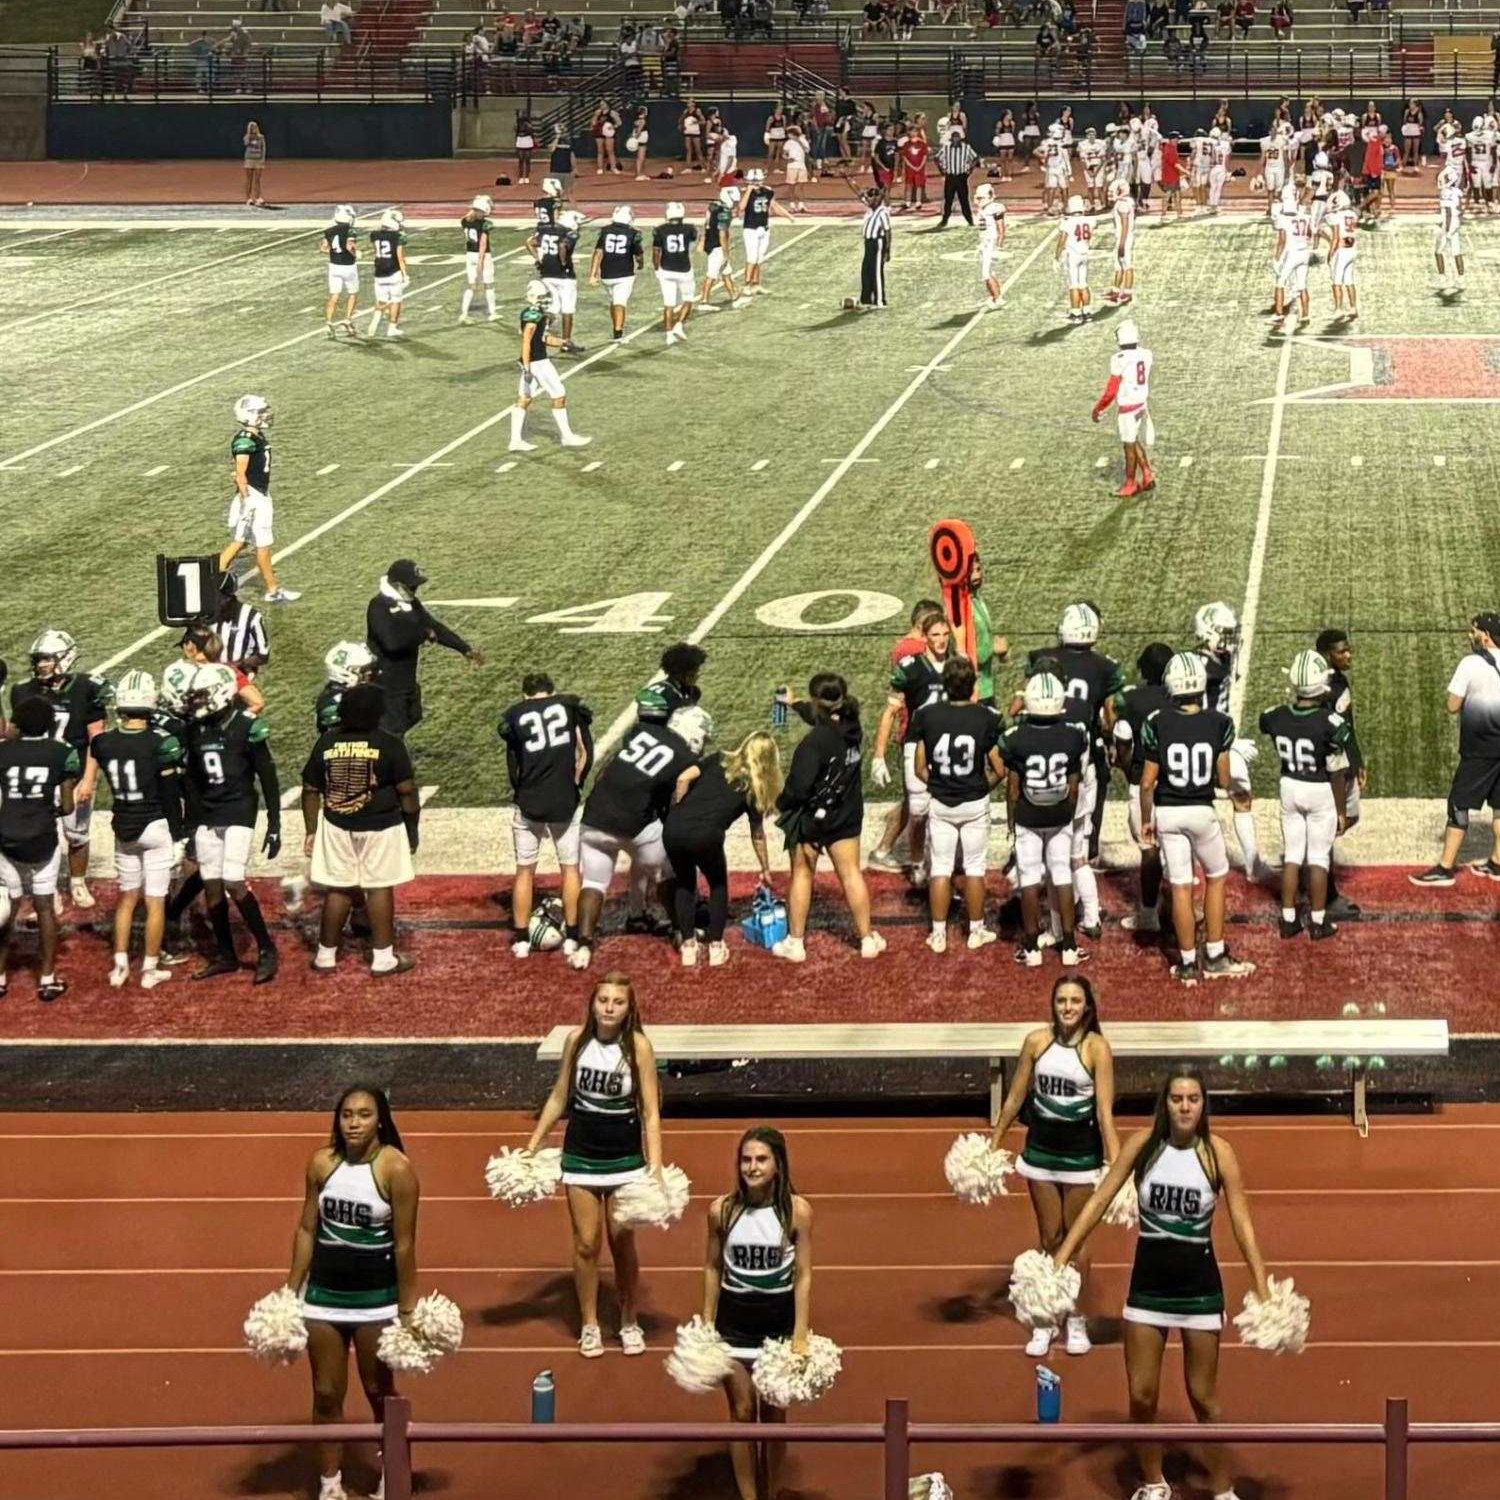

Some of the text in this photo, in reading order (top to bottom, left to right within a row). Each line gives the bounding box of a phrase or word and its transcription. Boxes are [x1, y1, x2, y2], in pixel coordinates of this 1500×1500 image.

[332, 234, 342, 253] 4
[604, 233, 627, 254] 62
[666, 234, 685, 253] 61
[1074, 223, 1092, 242] 48
[374, 239, 392, 258] 12
[1136, 361, 1146, 385] 8
[177, 562, 201, 614] 1
[518, 703, 571, 753] 32
[203, 751, 225, 785] 9
[618, 730, 675, 778] 50
[932, 733, 976, 777] 43
[1167, 742, 1213, 788] 90
[6, 765, 49, 799] 17
[108, 758, 144, 801] 11
[579, 1066, 623, 1094] RHS
[1037, 1073, 1077, 1097] RHS
[324, 1196, 372, 1226] RHS
[1151, 1183, 1202, 1215] RHS
[732, 1244, 782, 1270] RHS
